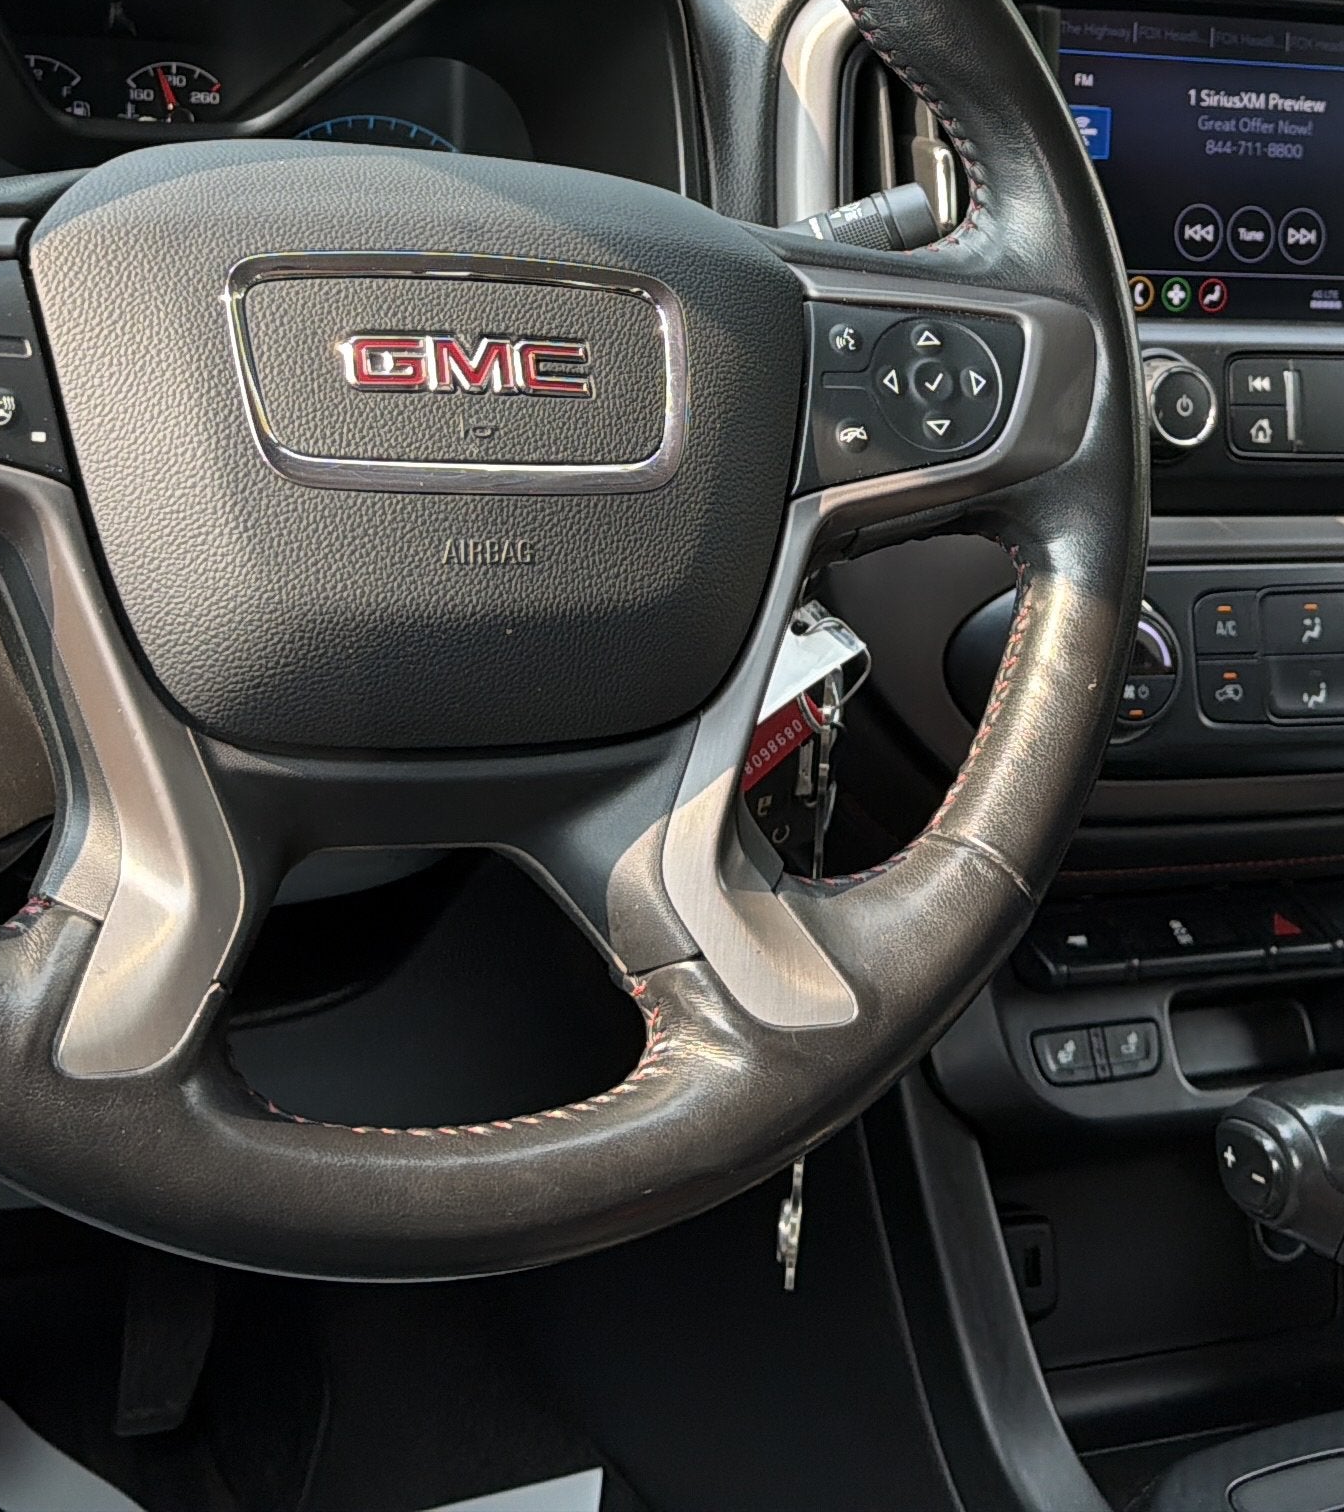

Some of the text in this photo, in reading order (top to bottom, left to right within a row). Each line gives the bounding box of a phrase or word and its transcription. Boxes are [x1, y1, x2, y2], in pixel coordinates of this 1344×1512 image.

[1074, 73, 1094, 87] FM
[129, 89, 154, 101] 160
[190, 92, 221, 105] 260
[1188, 89, 1326, 113] 1 SiriusXM Preview
[1198, 115, 1313, 136] Great Offer Now!
[1205, 139, 1304, 159] 844-711-8800
[1238, 228, 1264, 242] Tune
[334, 330, 596, 400] GMC
[441, 538, 535, 567] AIRBAG
[1216, 621, 1237, 637] A/C
